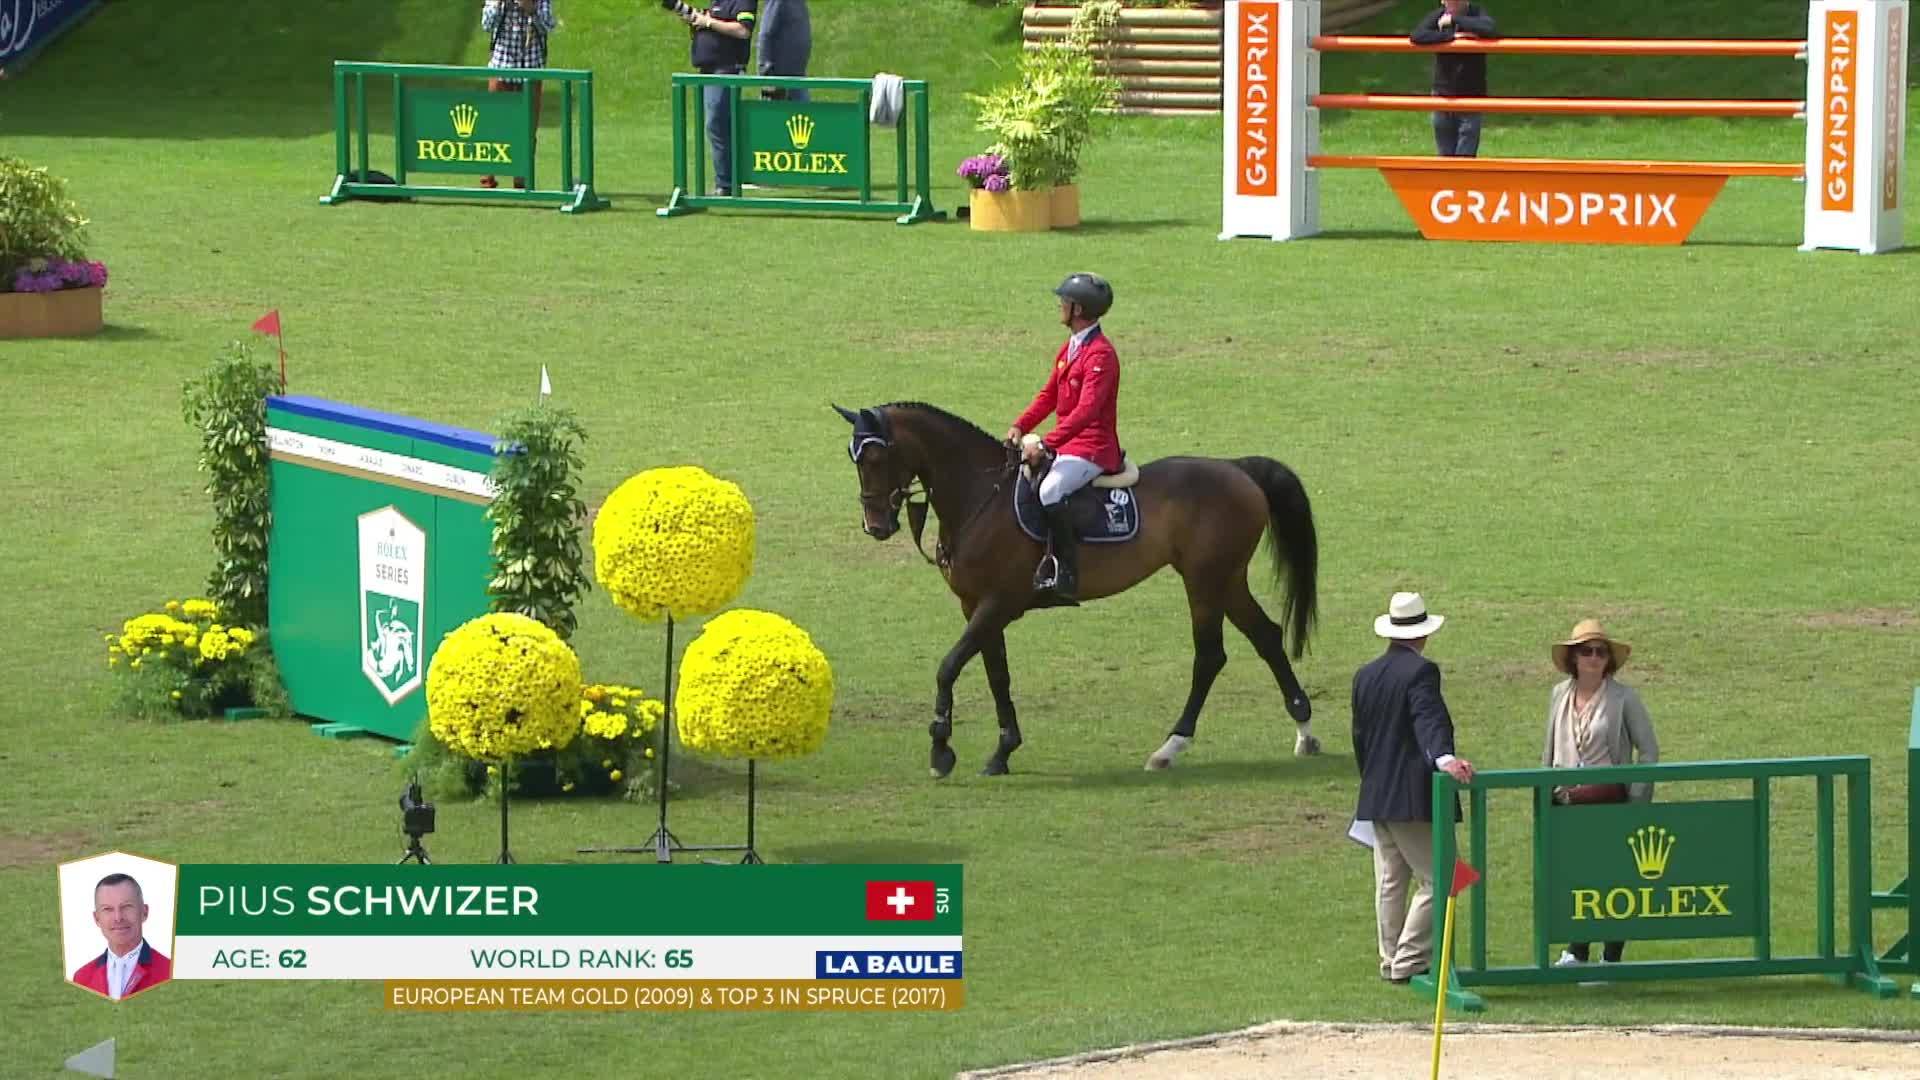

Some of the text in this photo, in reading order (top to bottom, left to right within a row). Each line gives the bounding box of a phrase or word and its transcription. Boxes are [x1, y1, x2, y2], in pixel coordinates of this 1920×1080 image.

[1245, 12, 1269, 186] GRANDPRIX
[1828, 20, 1851, 202] GRANDPRIX
[416, 139, 513, 163] ROLEX
[752, 151, 848, 174] ROLEX
[1430, 190, 1678, 228] GRANDPRIX
[376, 541, 408, 561] ROLEX
[375, 563, 409, 585] SERIES
[1571, 884, 1732, 920] ROLEX
